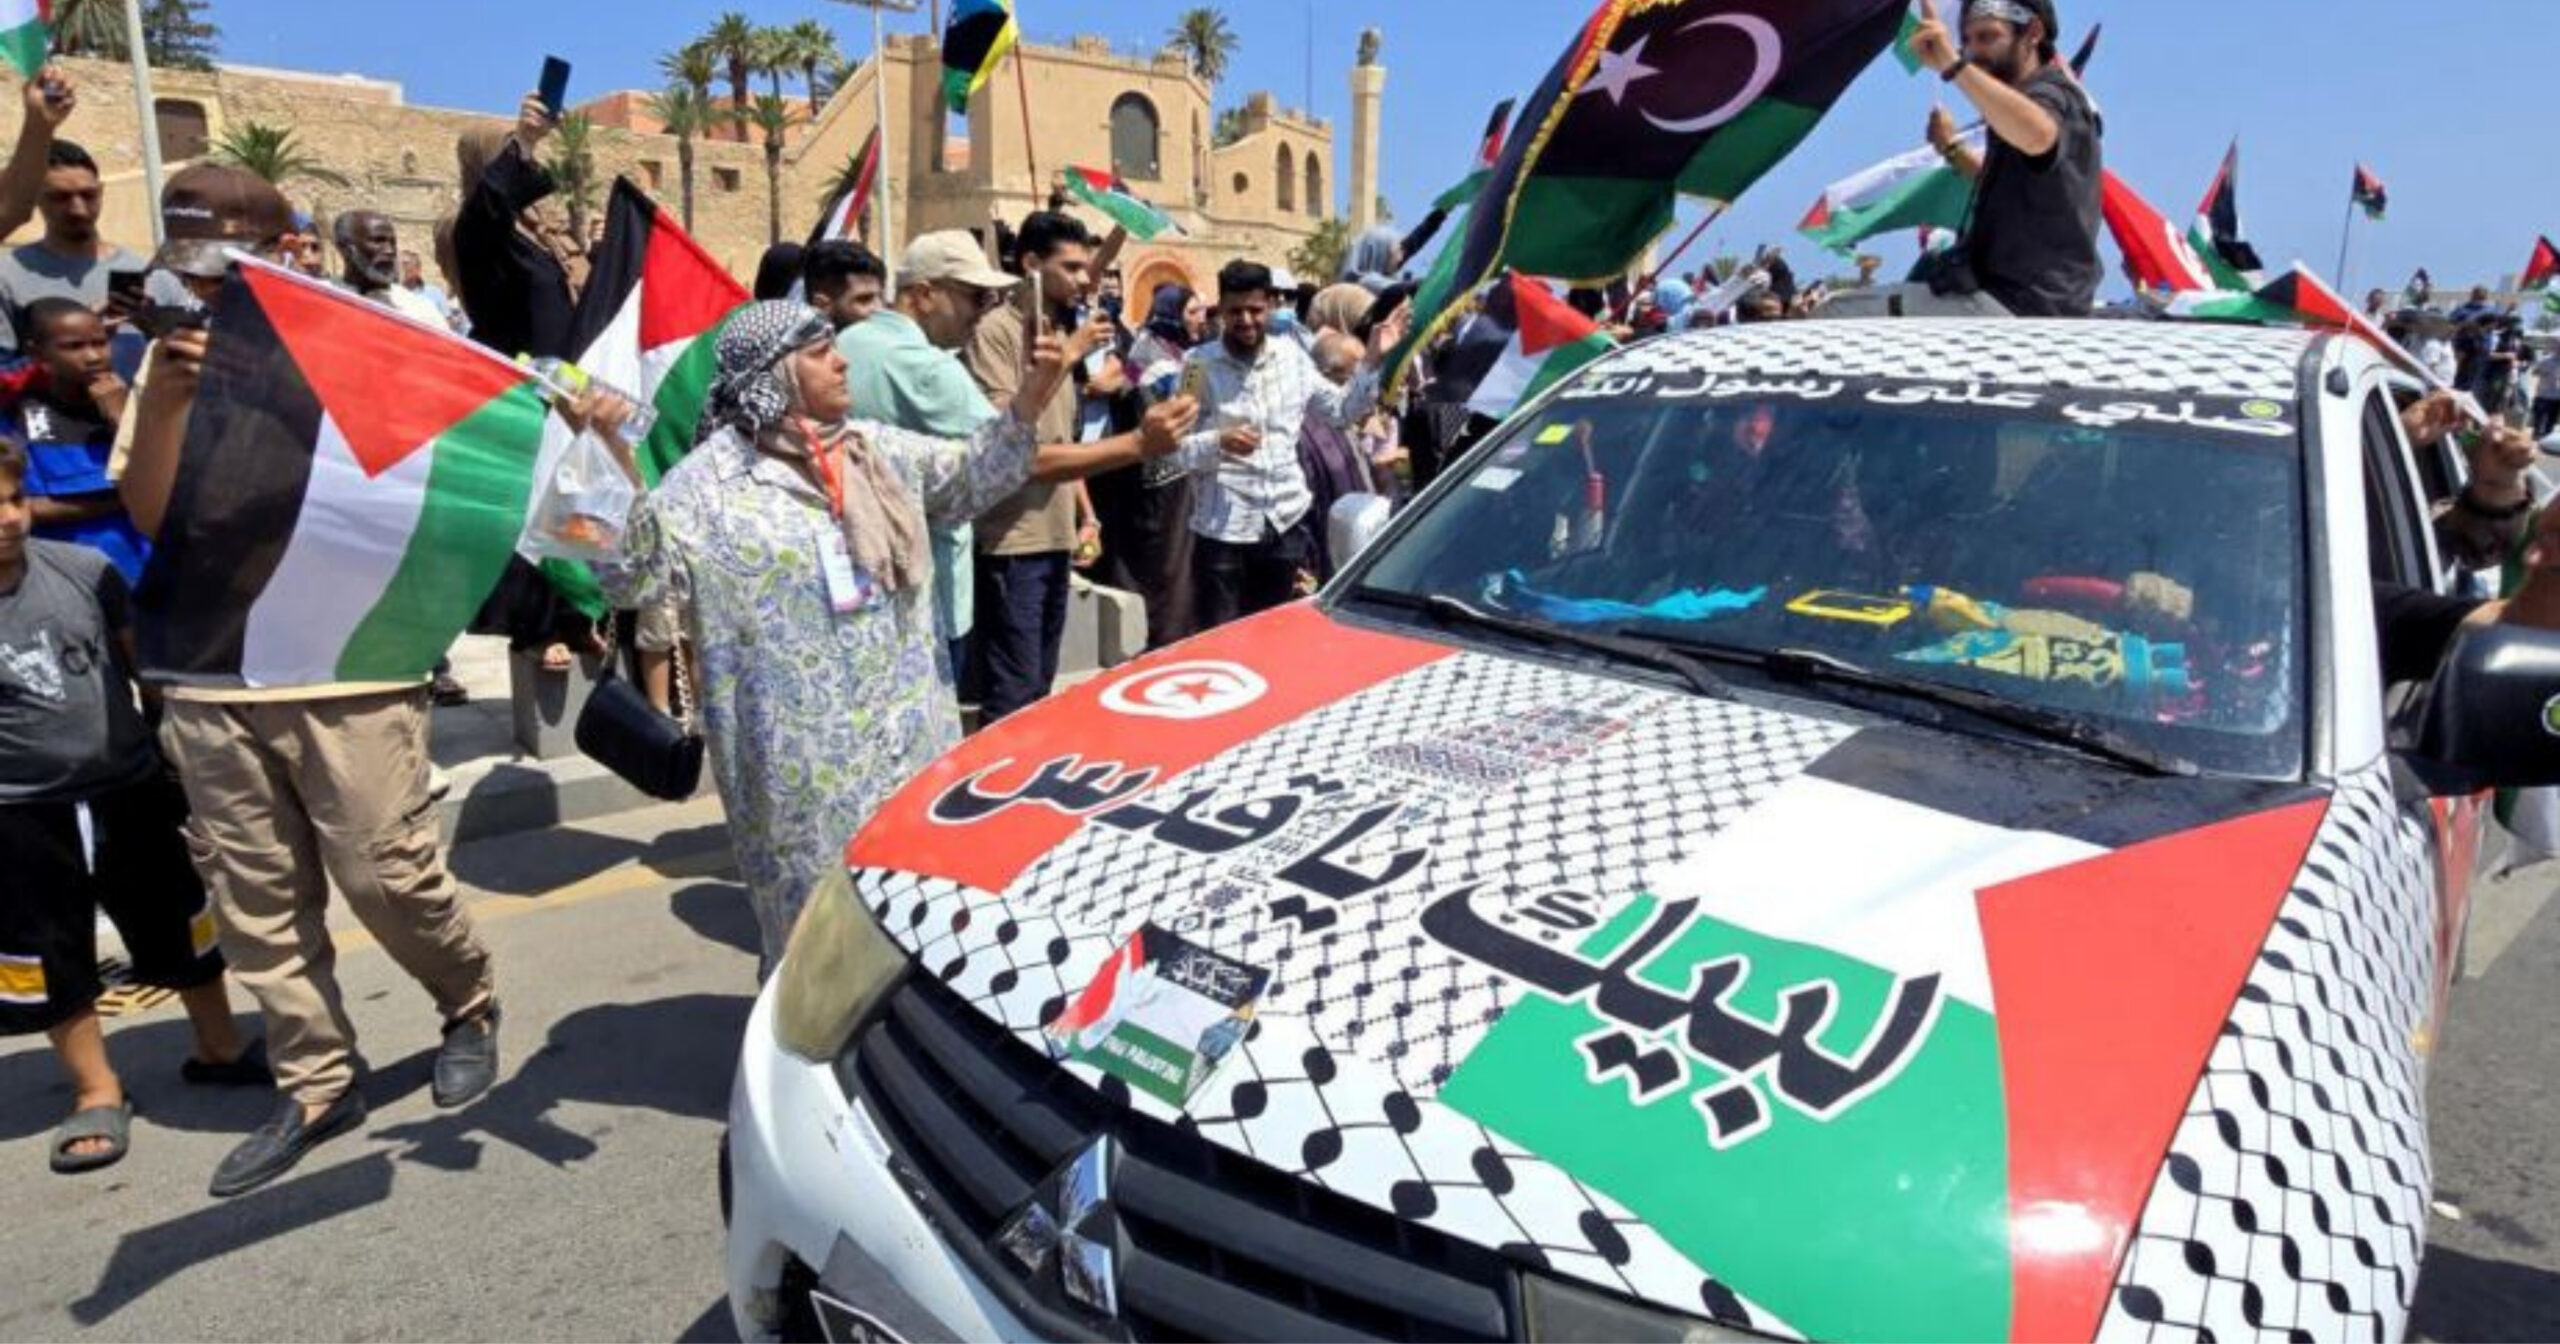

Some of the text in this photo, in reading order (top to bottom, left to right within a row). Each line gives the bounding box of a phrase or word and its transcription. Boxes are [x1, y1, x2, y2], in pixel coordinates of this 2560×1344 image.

[1560, 374, 2294, 437] صلي على رسول الله
[929, 754, 1941, 1141] لبيك يا قدس
